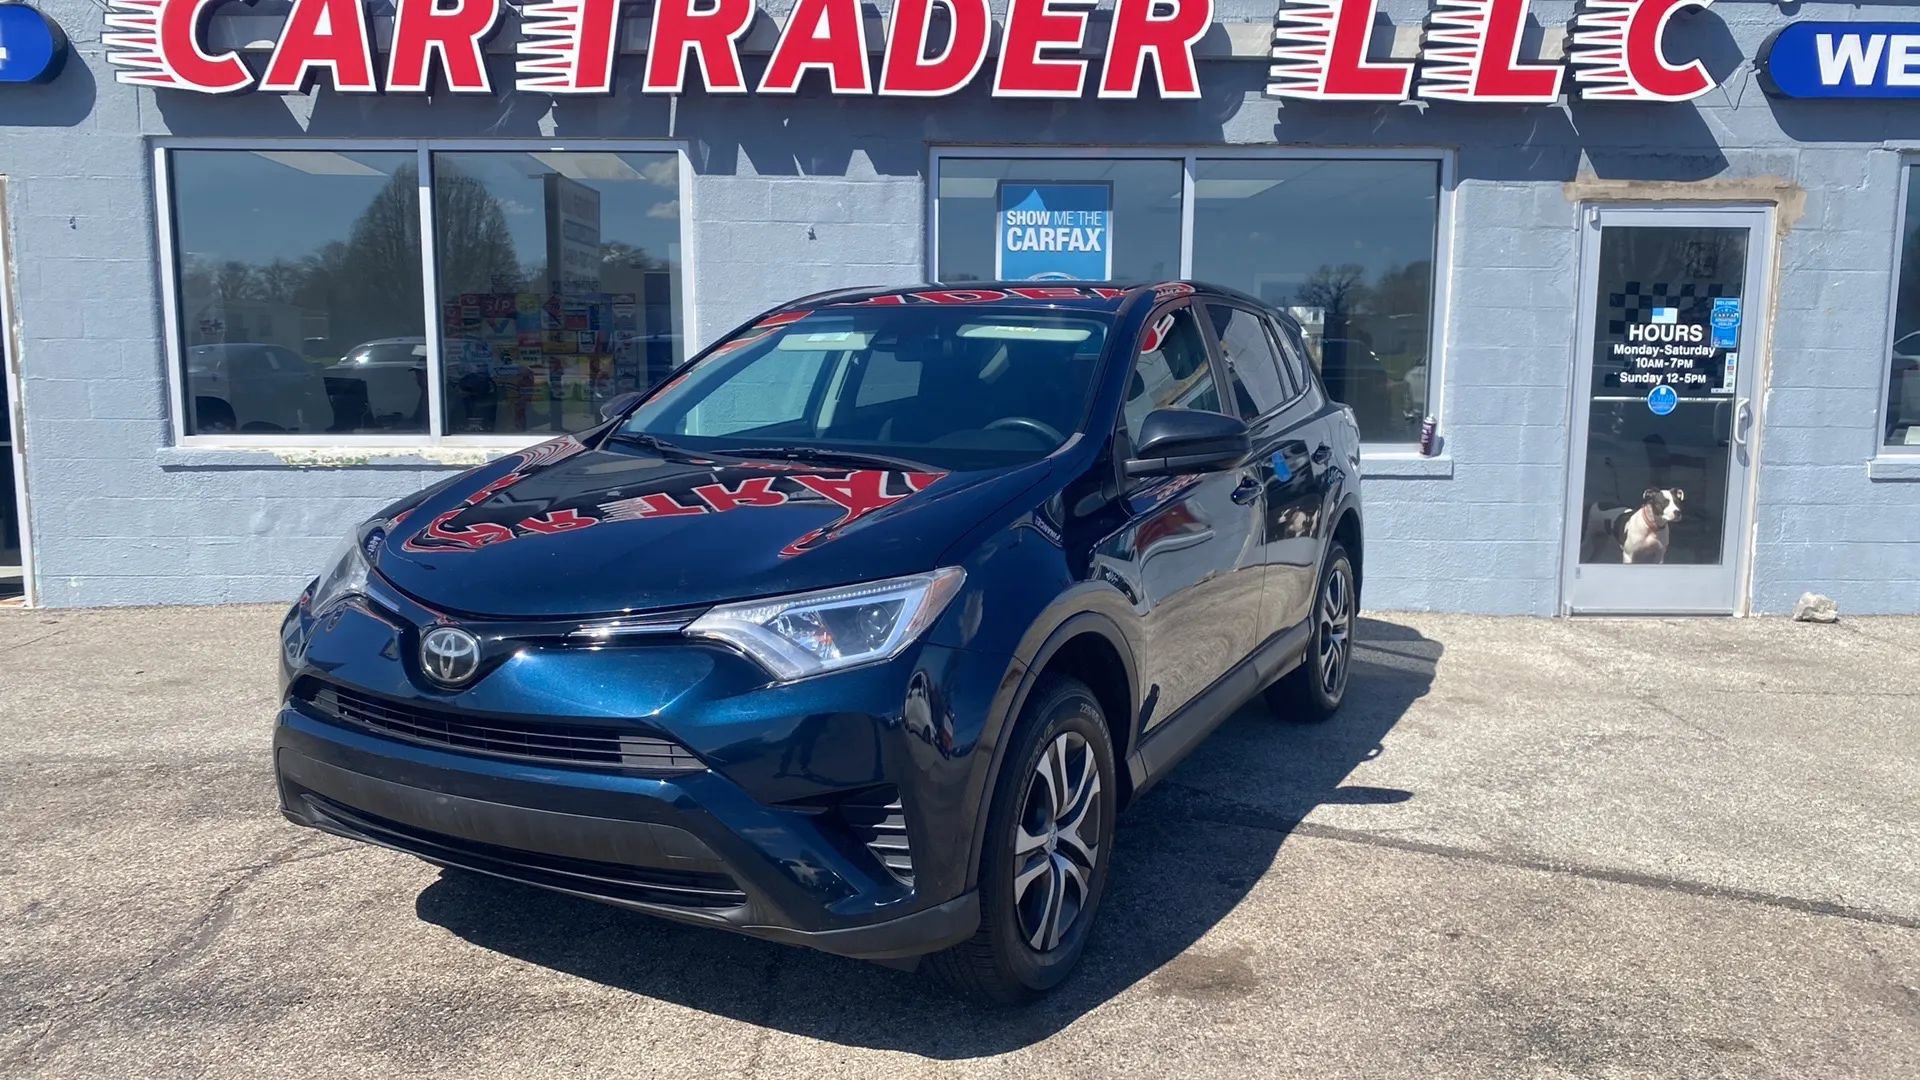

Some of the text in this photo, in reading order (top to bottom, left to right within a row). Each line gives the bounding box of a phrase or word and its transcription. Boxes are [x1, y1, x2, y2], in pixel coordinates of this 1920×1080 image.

[101, 0, 491, 94] CAR
[1006, 210, 1102, 226] SHOW ME THE
[1006, 226, 1102, 252] CARFAX
[1629, 324, 1703, 342] HOURS
[1614, 344, 1715, 357] Monday-Saturday
[1620, 372, 1706, 385] Sunday 12-5PM
